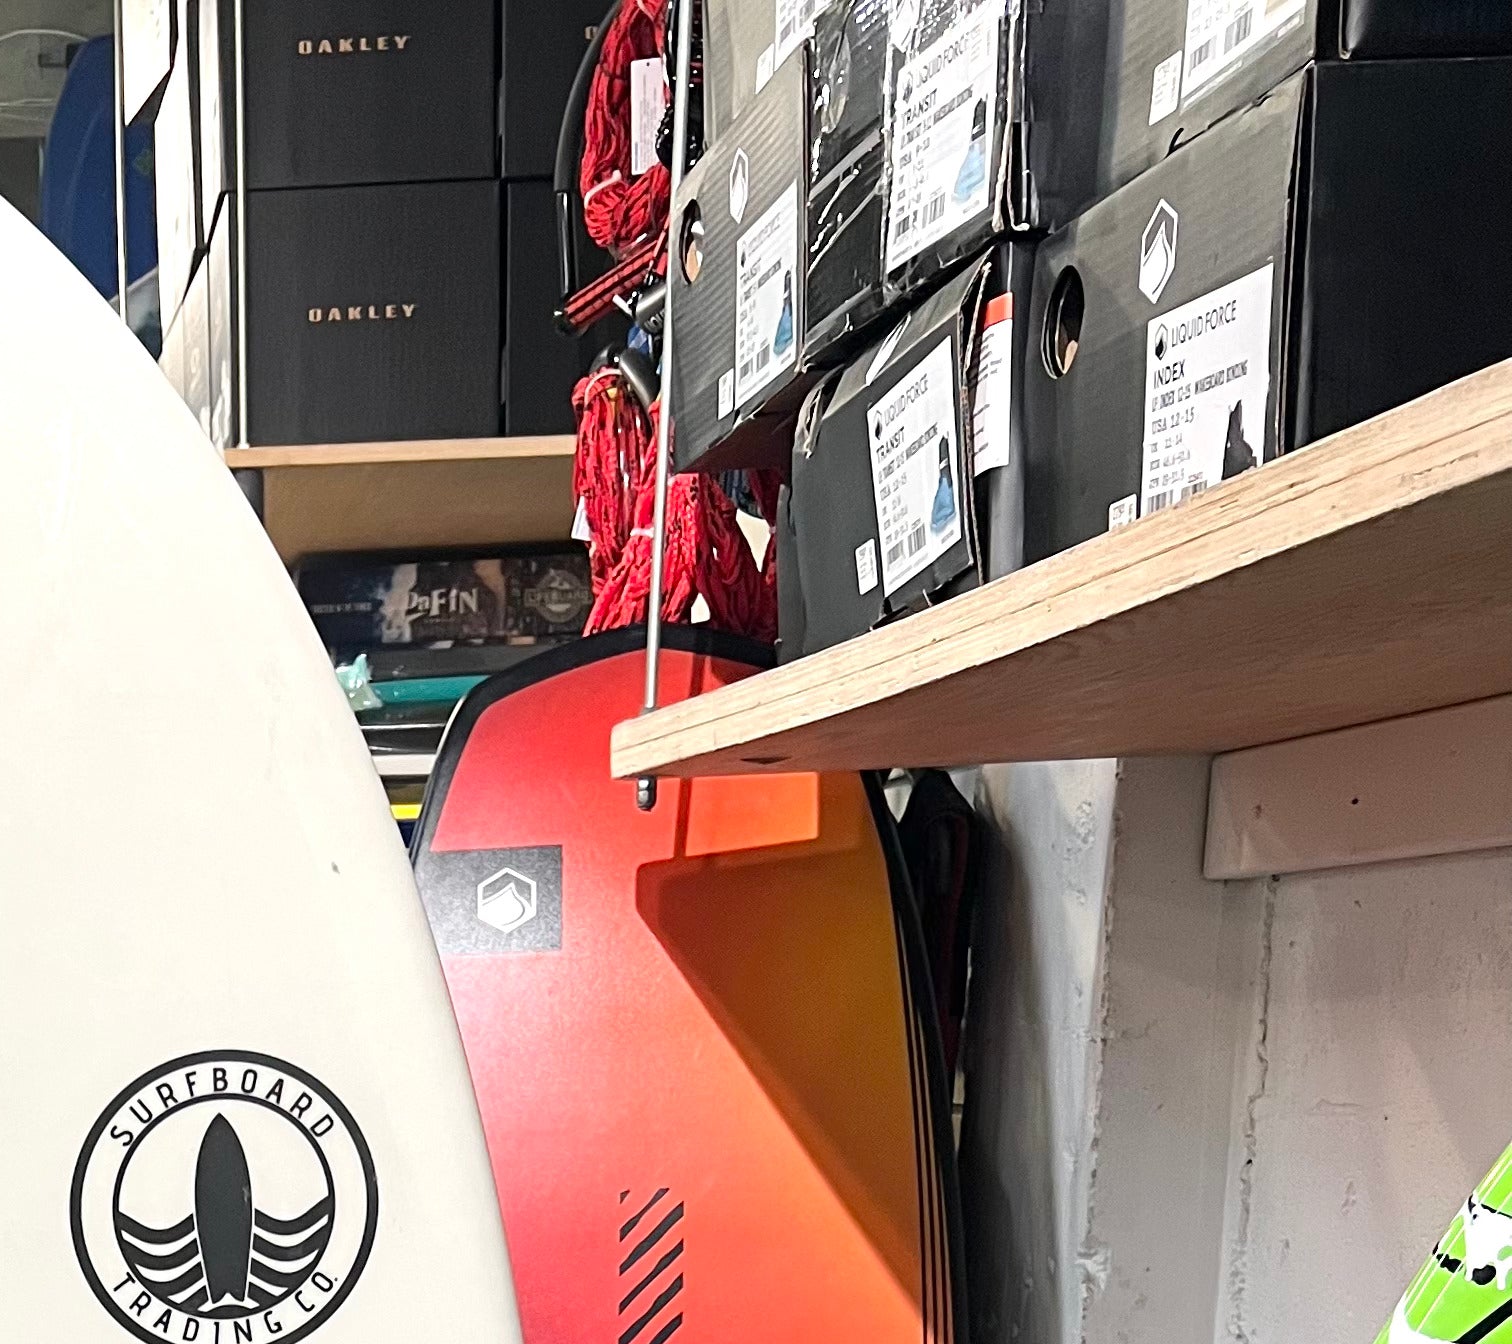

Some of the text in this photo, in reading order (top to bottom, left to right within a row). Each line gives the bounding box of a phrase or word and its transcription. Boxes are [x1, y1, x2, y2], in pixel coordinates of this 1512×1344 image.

[297, 35, 411, 55] OAKLEY
[307, 303, 417, 323] OAKLEY
[1172, 300, 1238, 348] LIQUID FORCE
[1153, 359, 1186, 390] INDEX
[876, 426, 905, 463] TRANSIT
[110, 1067, 335, 1148] SURFBOARD
